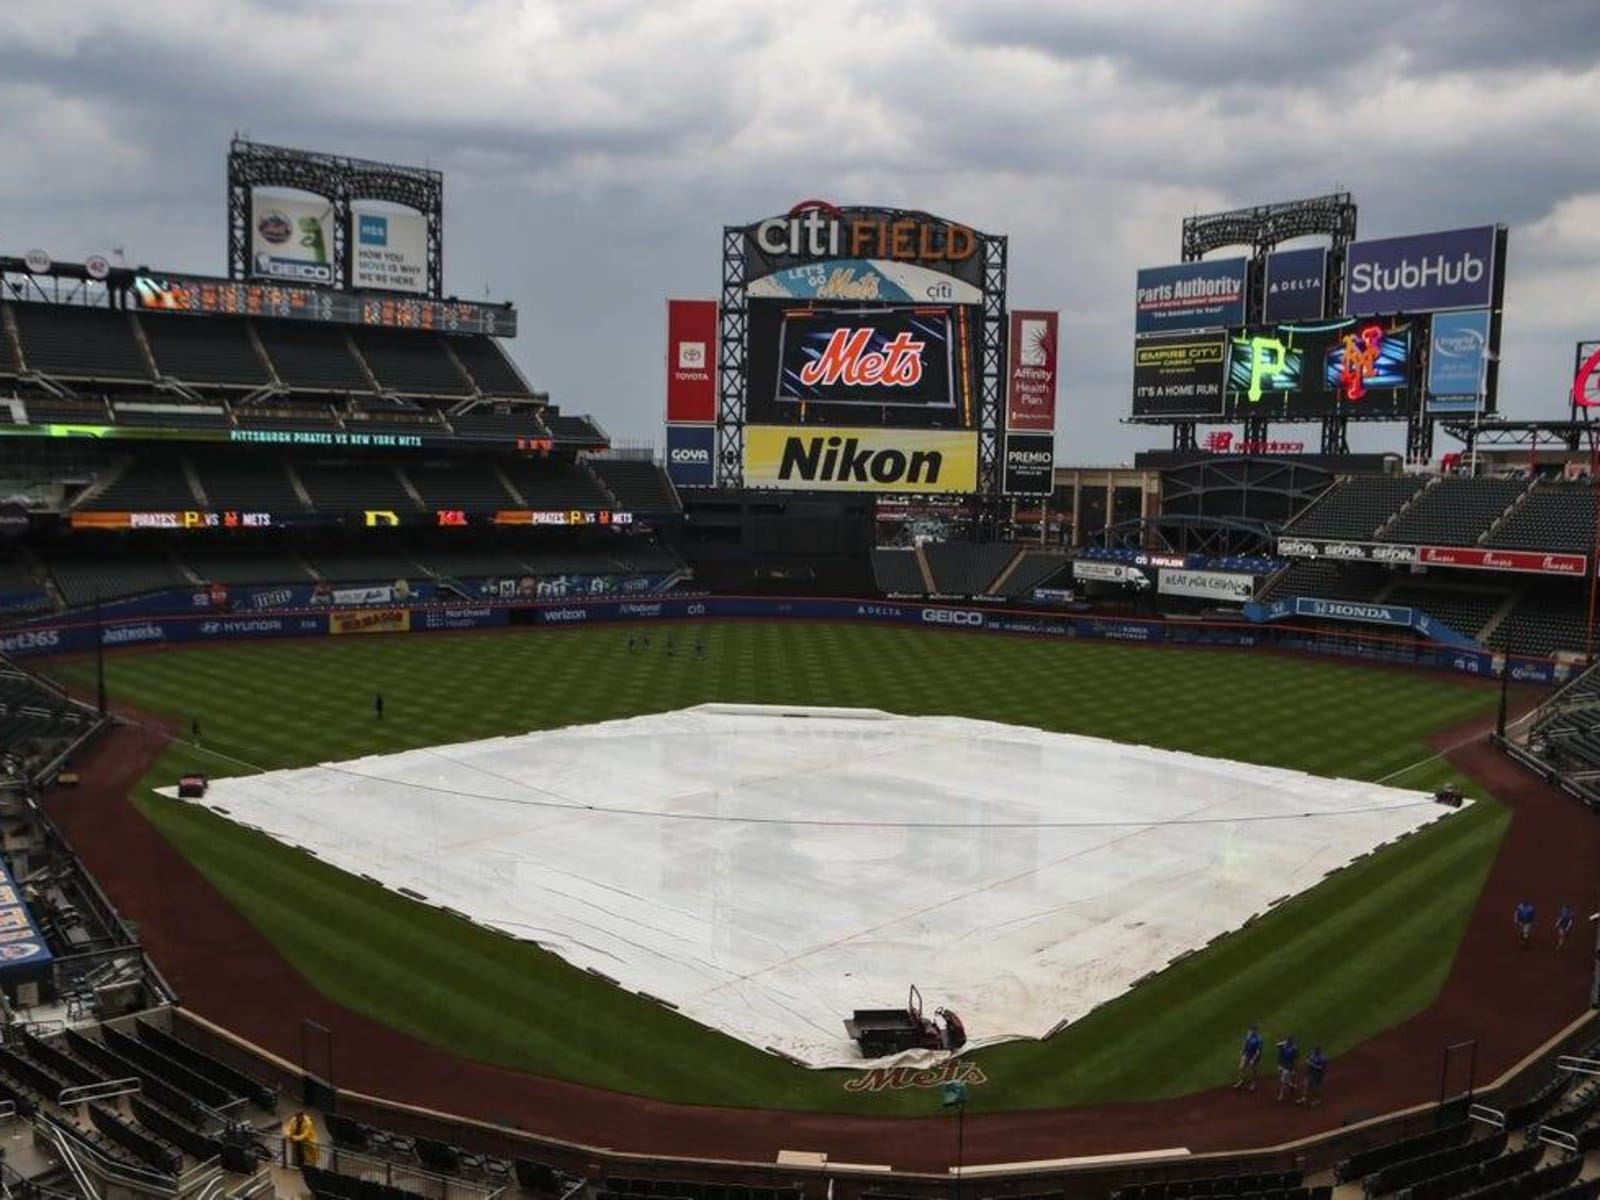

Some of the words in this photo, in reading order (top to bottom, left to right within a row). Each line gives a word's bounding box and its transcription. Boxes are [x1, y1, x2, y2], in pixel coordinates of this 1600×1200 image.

[851, 220, 976, 261] FIELD
[385, 252, 404, 262] YOU
[359, 260, 386, 271] MOVE
[388, 263, 399, 272] IS
[400, 264, 421, 275] WHY
[789, 265, 824, 279] LET'S
[1351, 252, 1483, 293] StubHub
[1138, 285, 1172, 302] Parts
[1174, 276, 1240, 299] Authority
[1281, 278, 1320, 290] DELTA
[801, 328, 925, 386] Mets
[1140, 350, 1185, 361] EMPIRE
[1189, 348, 1218, 358] CITY
[675, 372, 708, 380] TOYOTA
[1014, 368, 1052, 382] Affinity
[1016, 382, 1049, 393] Health
[1137, 386, 1155, 397] IT'S
[1156, 386, 1164, 396] A
[1165, 385, 1194, 396] HOME
[1196, 384, 1219, 395] RUN
[1021, 394, 1042, 405] Plan
[231, 430, 291, 442] PITTSBURGH
[294, 432, 332, 443] PIRATES
[335, 434, 348, 444] VS
[351, 435, 370, 444] NEW
[373, 435, 395, 445] YORK
[398, 436, 422, 446] METS
[778, 436, 942, 483] Nikon
[1008, 452, 1051, 463] PREMIO
[130, 513, 176, 527] PIRATES
[204, 514, 219, 526] VS
[243, 513, 271, 526] METS
[533, 511, 564, 524] PIRATES
[613, 512, 632, 523] METS
[446, 608, 491, 617] Northwell
[544, 609, 587, 621] verizon
[868, 606, 901, 616] DELTA
[922, 608, 983, 625] GEICO
[1329, 606, 1391, 620] HONDA
[224, 621, 281, 632] HYUNDAI
[843, 1059, 988, 1092] Mets
